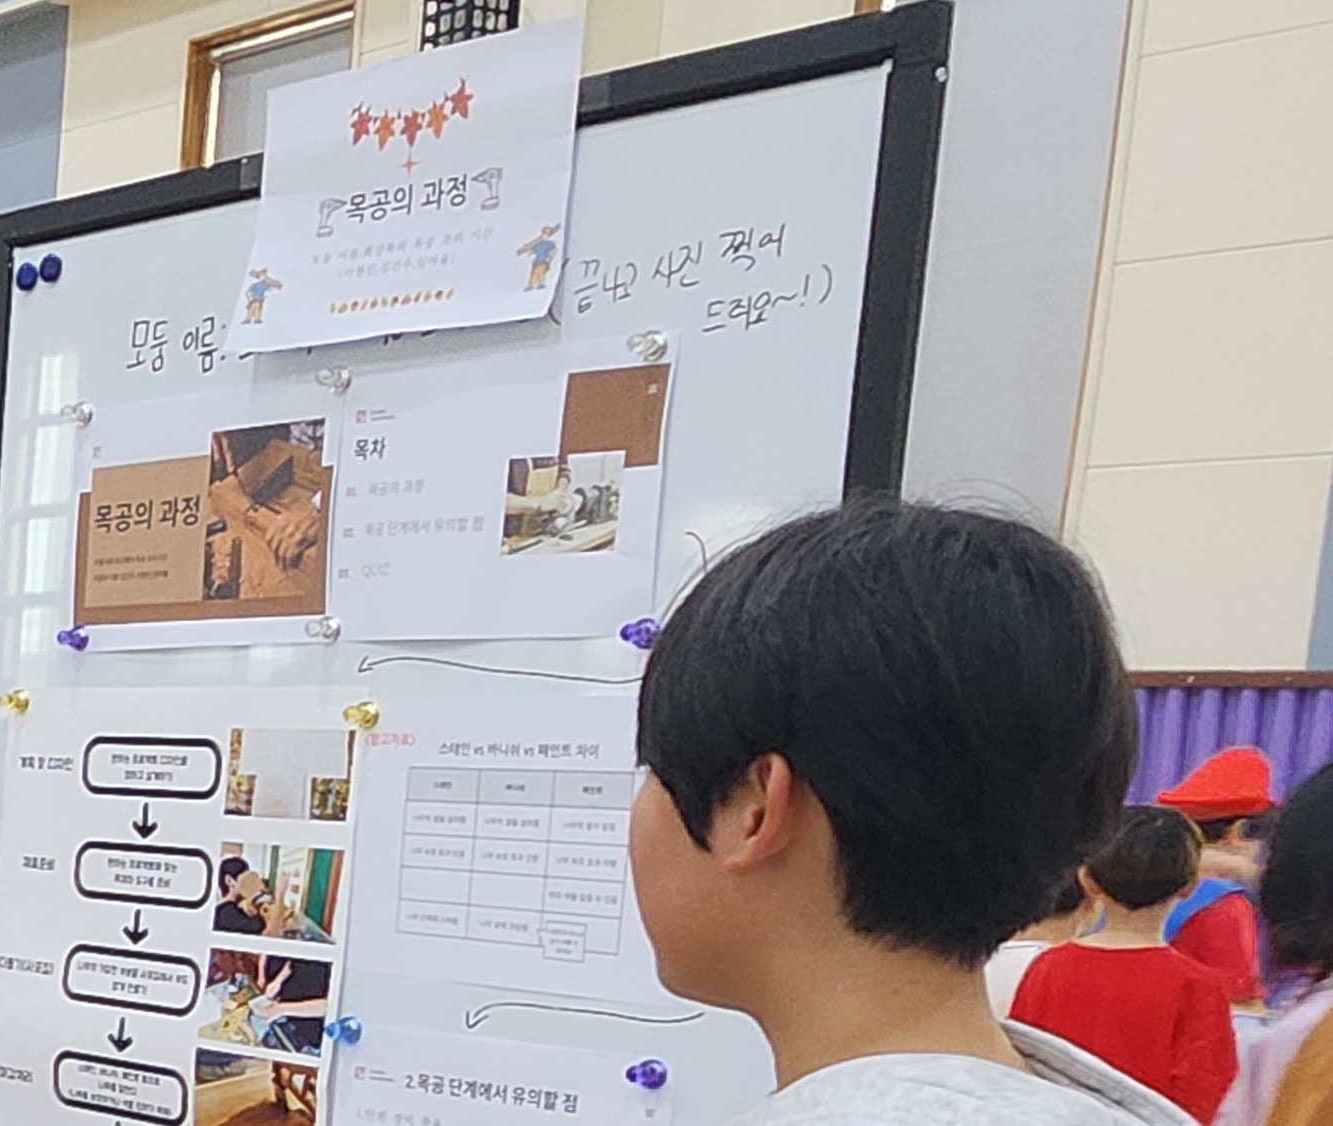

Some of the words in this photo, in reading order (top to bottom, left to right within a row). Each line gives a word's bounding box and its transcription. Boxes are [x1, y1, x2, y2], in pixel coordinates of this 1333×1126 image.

[346, 184, 413, 223] 목공의
[421, 174, 468, 210] 과정
[651, 240, 703, 288] 사진
[720, 223, 786, 272] 찍어
[126, 319, 168, 373] 모둠
[354, 437, 386, 461] 목차
[94, 499, 153, 534] 목공의
[158, 494, 201, 528] 과정
[449, 1078, 508, 1104] 단계에서
[512, 1086, 558, 1111] 유의할
[562, 1093, 578, 1113] 점
